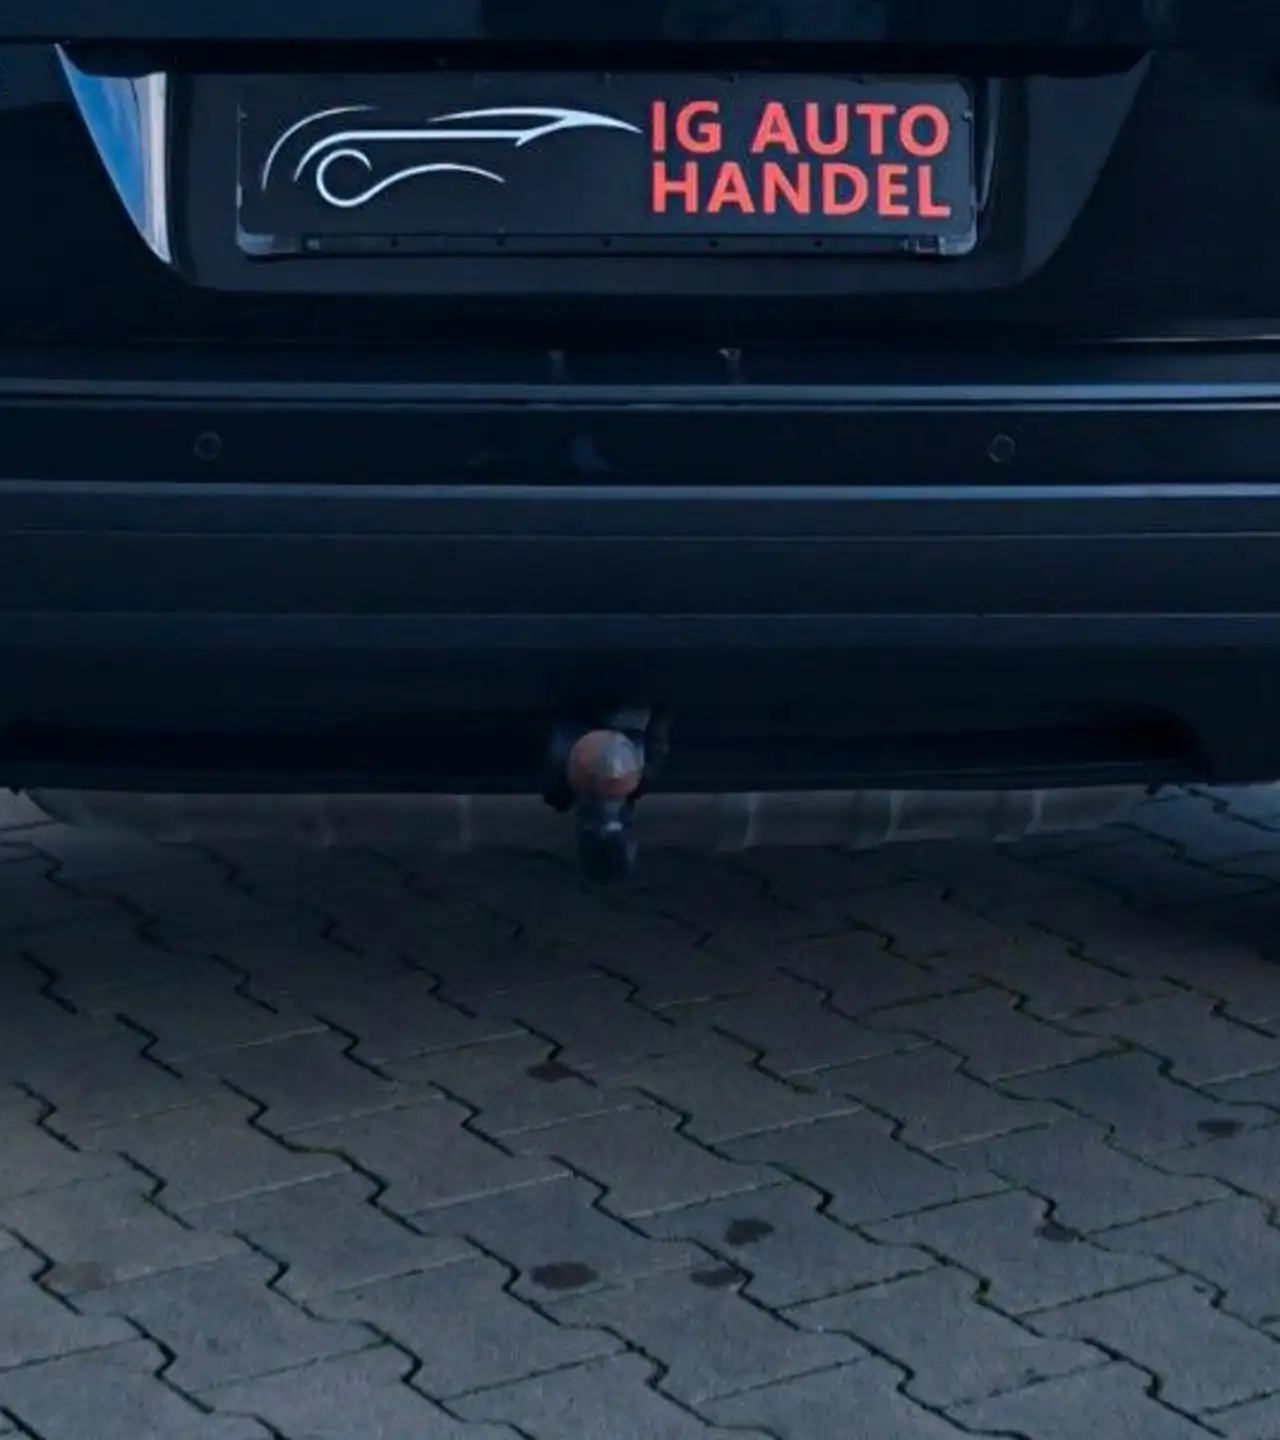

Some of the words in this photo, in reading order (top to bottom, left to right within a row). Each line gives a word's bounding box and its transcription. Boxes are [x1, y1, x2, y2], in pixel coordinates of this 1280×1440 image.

[653, 101, 720, 154] IG
[751, 102, 950, 157] AUTO
[652, 162, 951, 217] HANDEL
